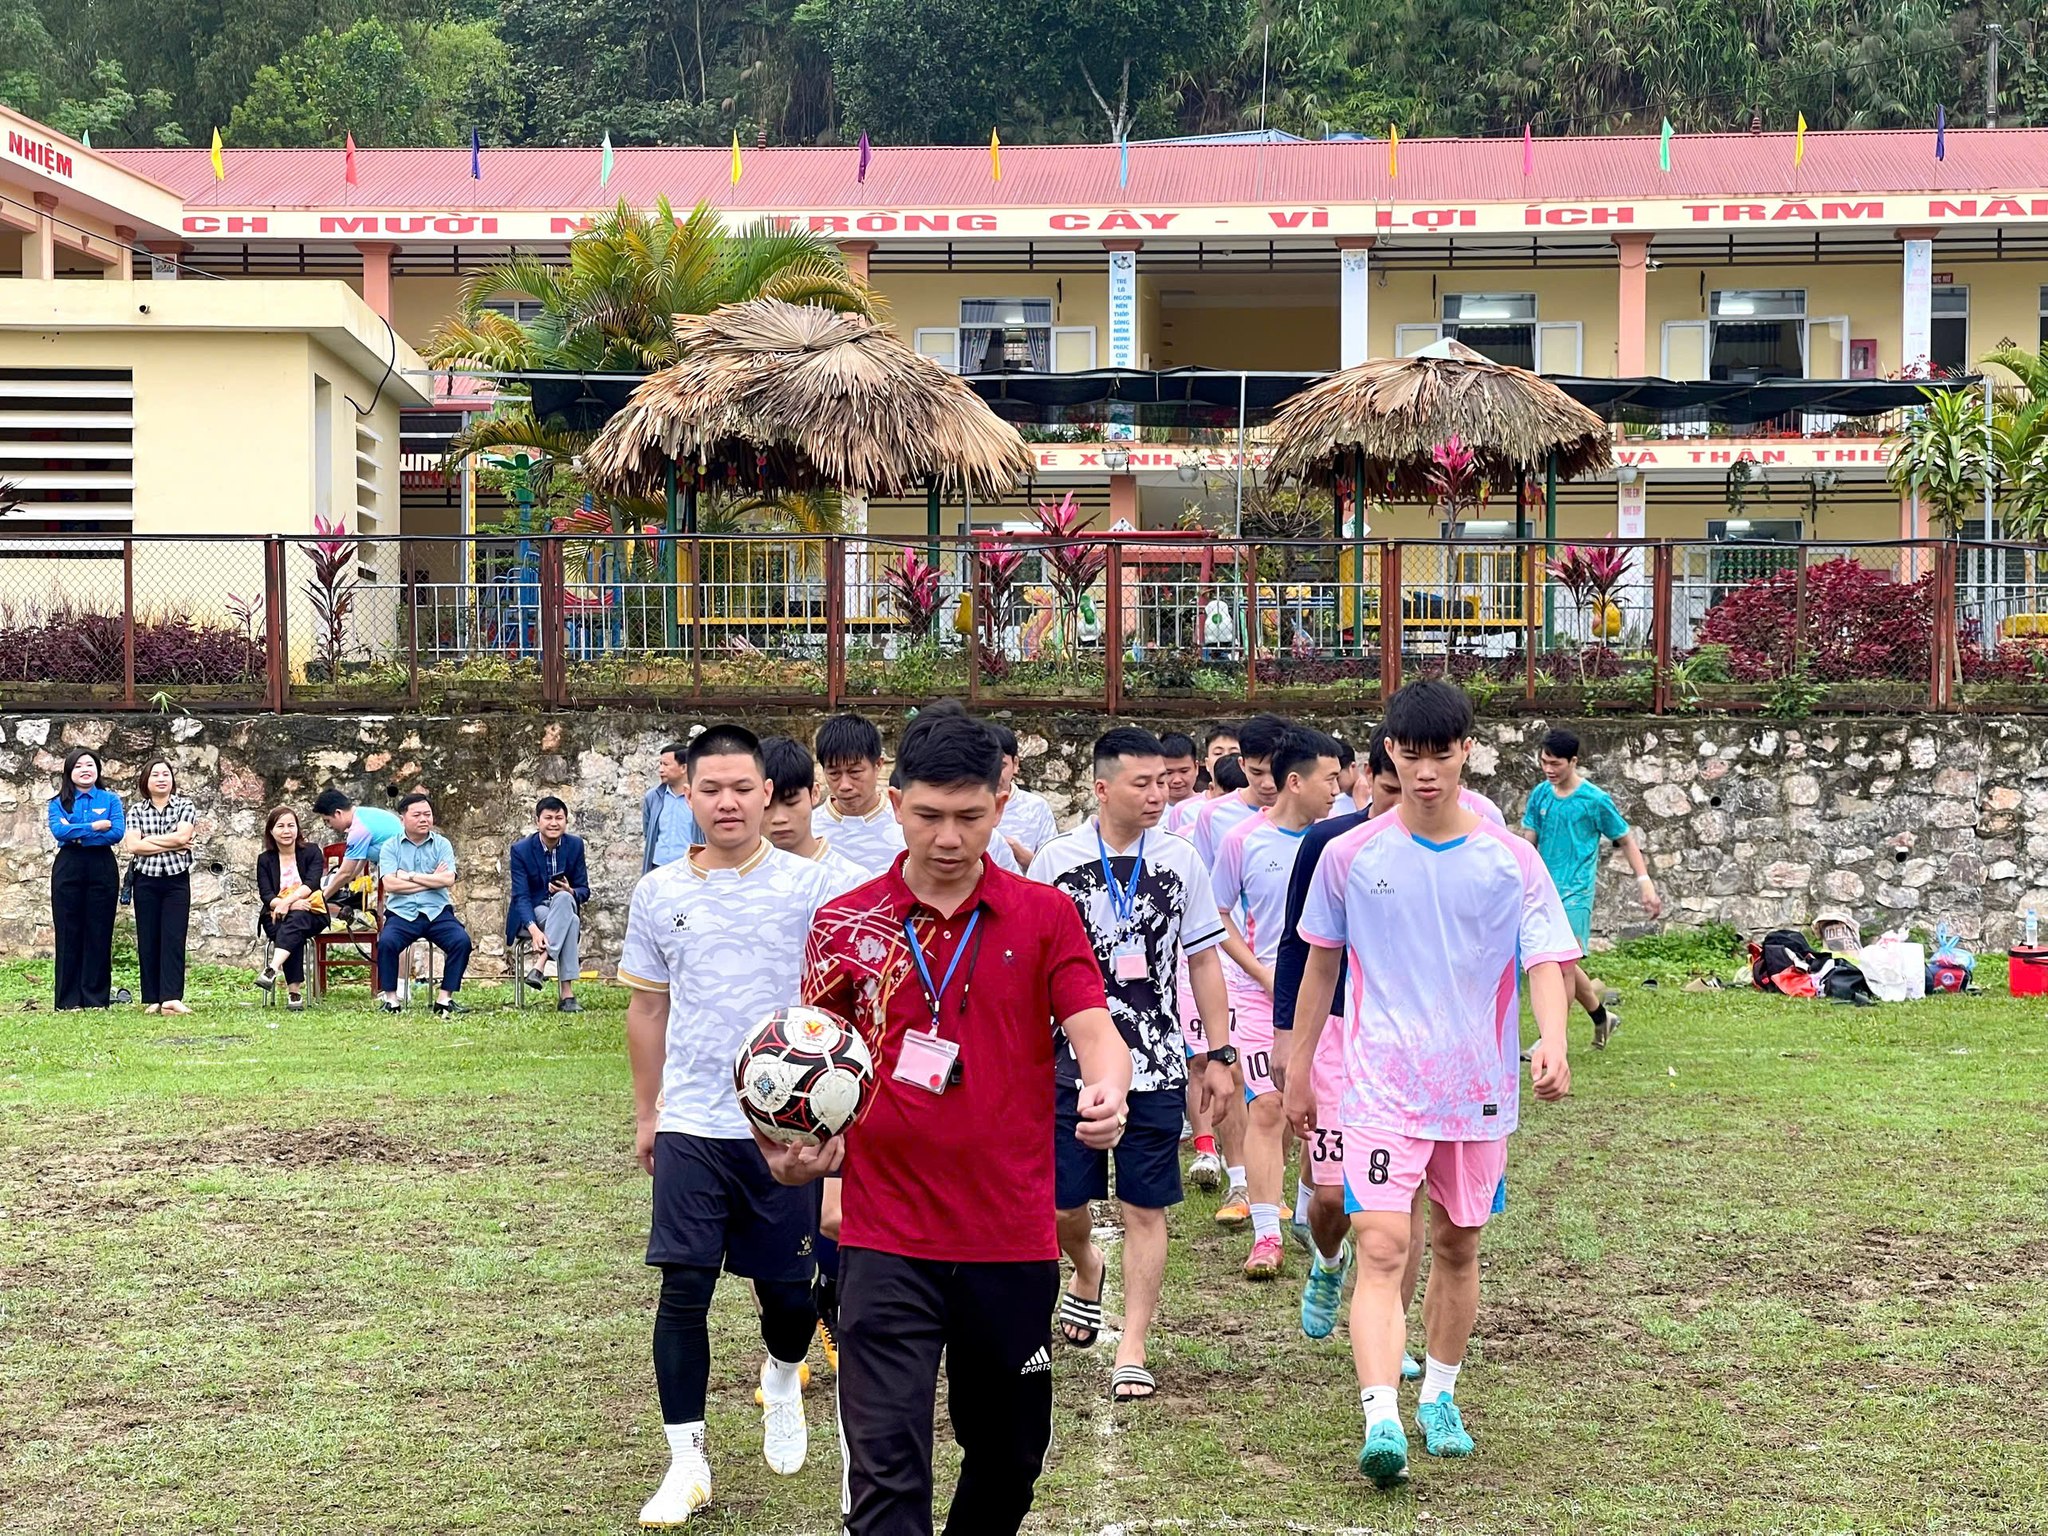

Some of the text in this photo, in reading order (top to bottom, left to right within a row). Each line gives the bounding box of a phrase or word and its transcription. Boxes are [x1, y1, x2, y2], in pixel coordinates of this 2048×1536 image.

[9, 130, 73, 179] NHIỆM
[320, 212, 498, 234] MƯỜI
[1049, 209, 1181, 231] CÂY
[1268, 207, 1329, 228] VÌ
[1375, 208, 1477, 232] LỢI
[1524, 204, 1635, 226] ÍCH
[1682, 198, 1884, 222] TRĂM
[1079, 454, 1182, 468] XNH,
[1617, 447, 1903, 464] VÀ THÂN THIỆ
[1190, 1018, 1202, 1040] 9
[1246, 1051, 1271, 1081] 10
[1313, 1128, 1344, 1162] 33
[1368, 1149, 1391, 1185] 8
[1021, 1362, 1051, 1374] SPORTS
